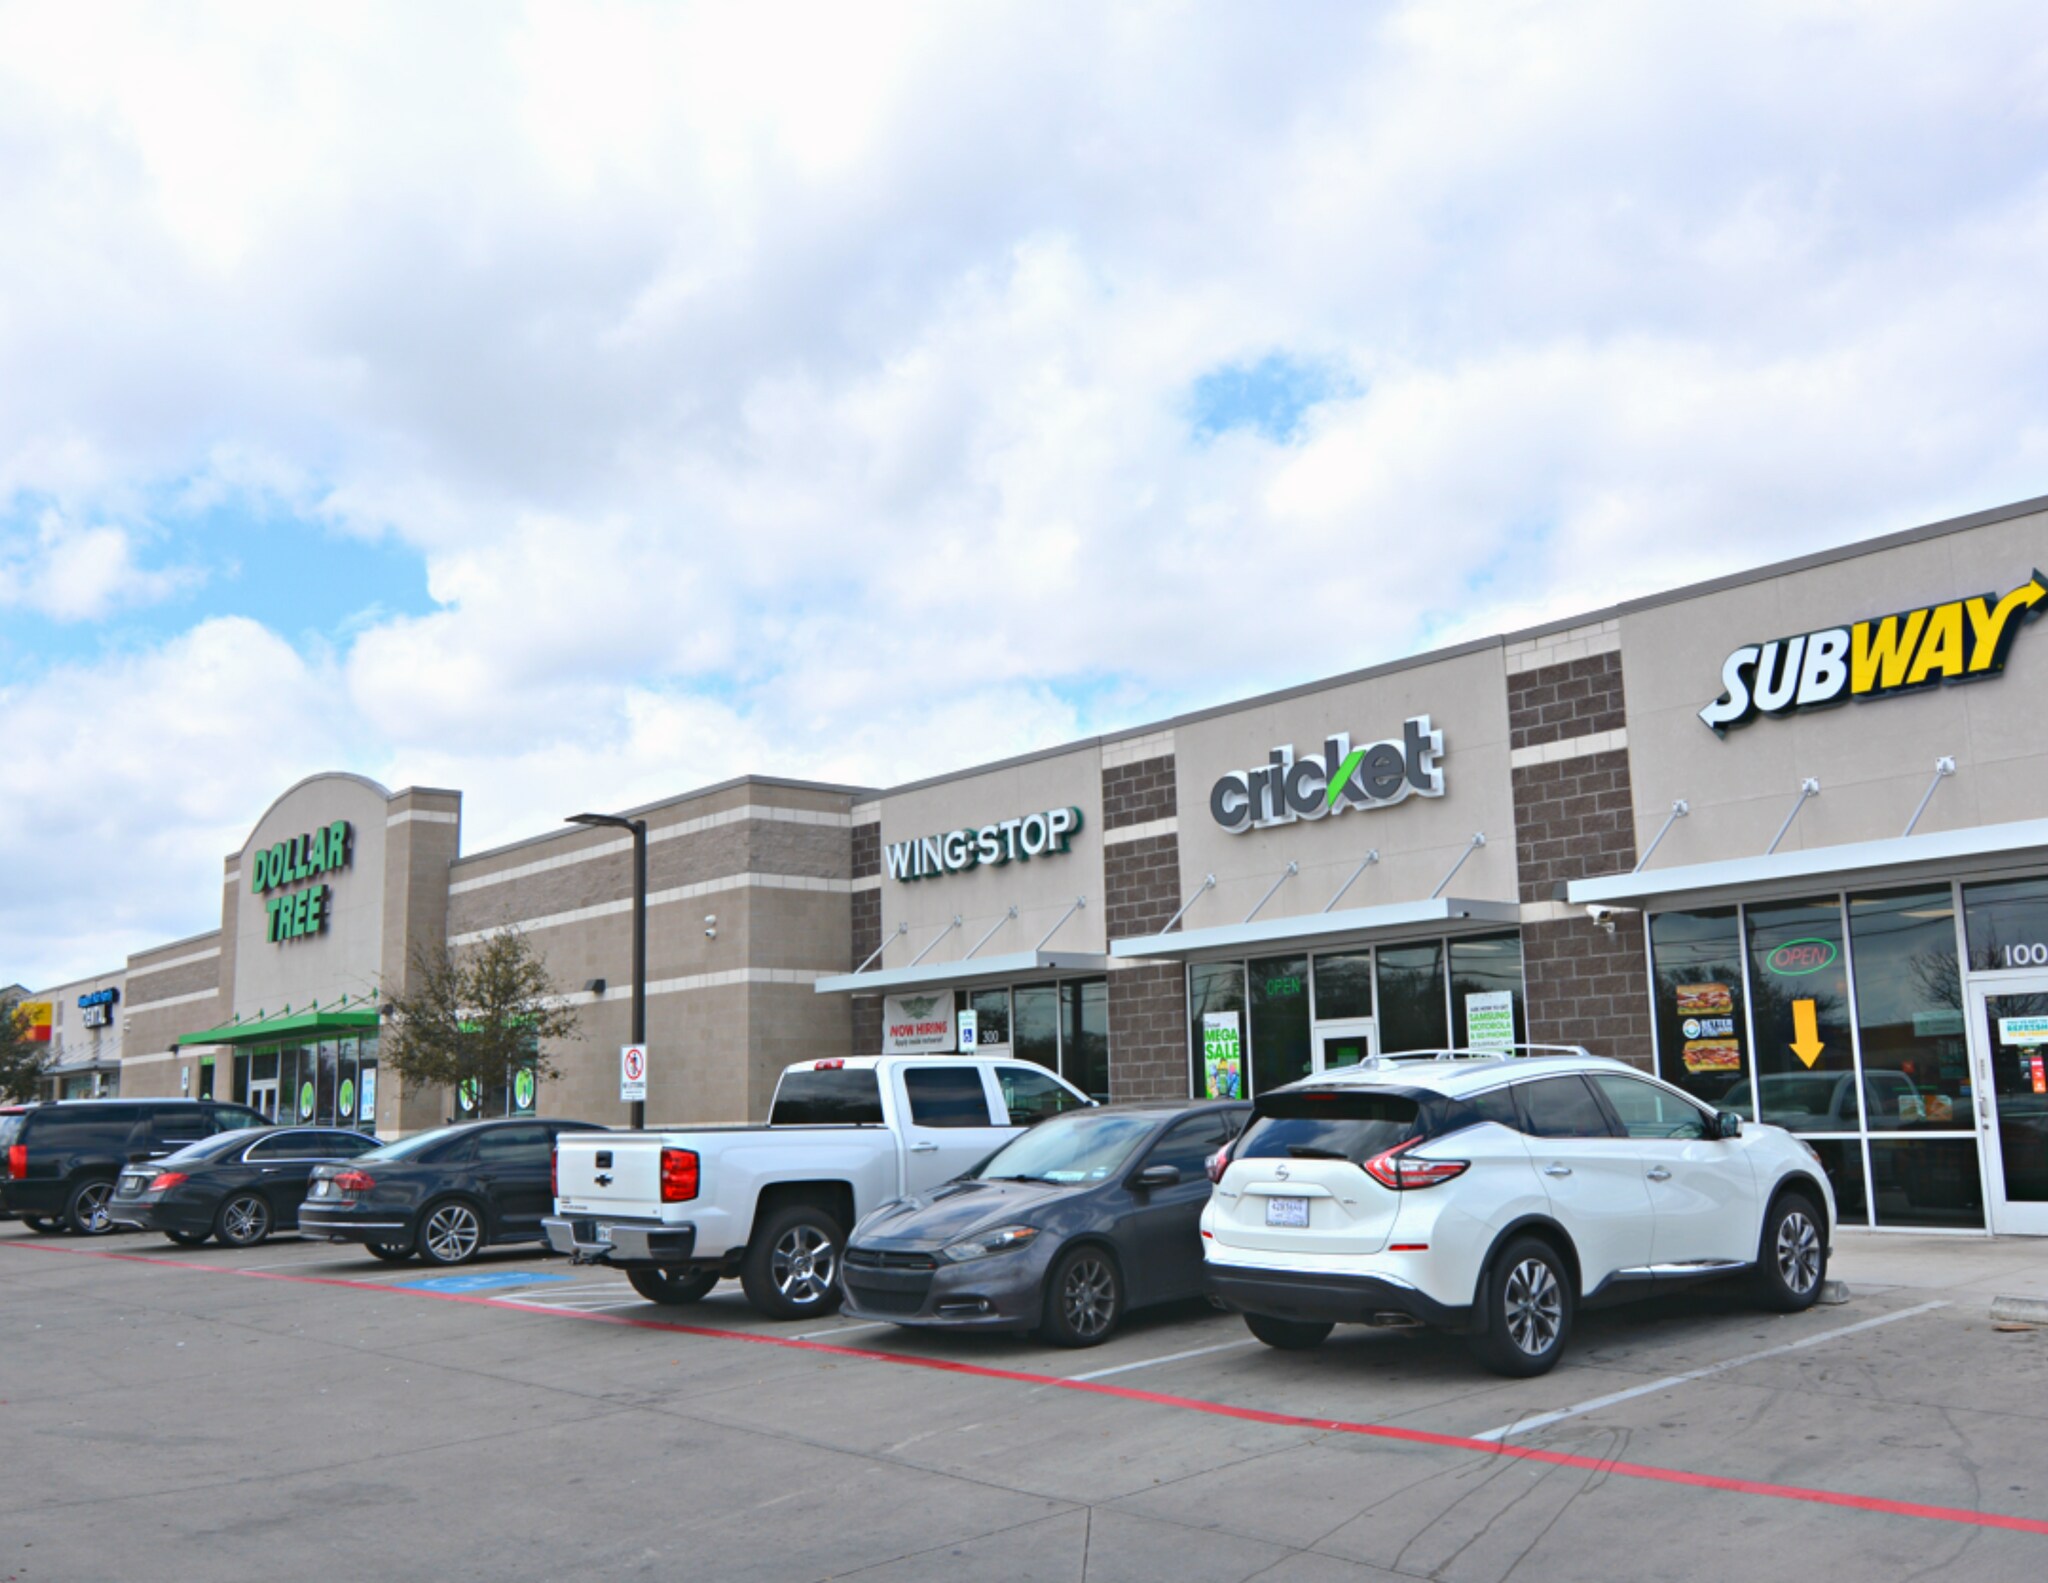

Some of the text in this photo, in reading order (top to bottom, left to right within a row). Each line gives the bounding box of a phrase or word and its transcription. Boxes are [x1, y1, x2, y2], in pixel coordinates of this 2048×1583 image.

[1698, 578, 2047, 728] SUBWAY
[1210, 716, 1440, 830] cricket
[252, 819, 349, 894] DOLLAR
[266, 884, 325, 943] TREE
[1775, 946, 1827, 967] OPEN
[2005, 943, 2048, 966] 100
[1265, 976, 1300, 997] OPEN
[890, 1020, 948, 1037] NOW HIRING
[982, 1029, 999, 1043] 300
[1205, 1028, 1238, 1041] MEGA
[1205, 1042, 1239, 1060] SALE
